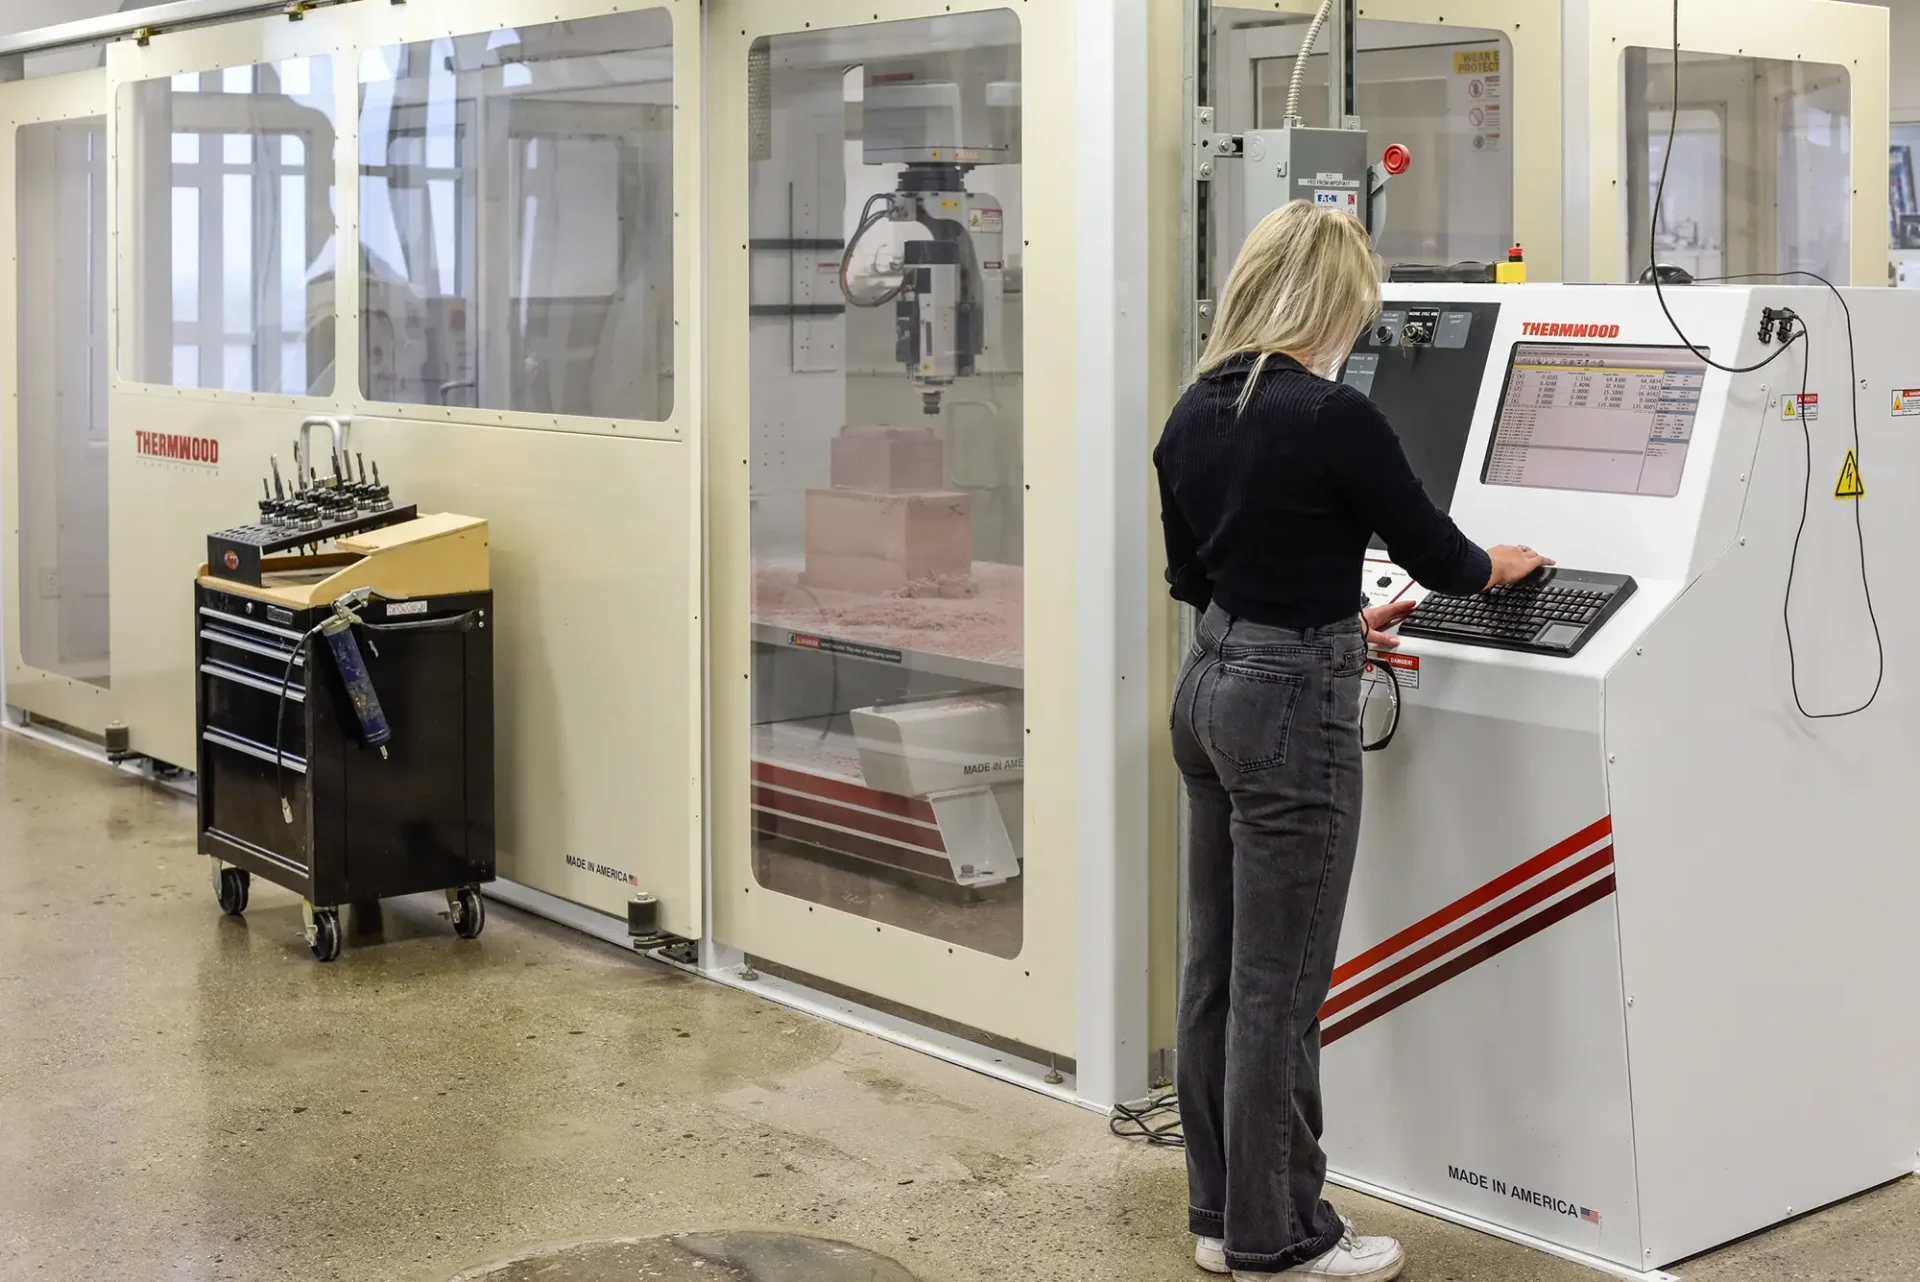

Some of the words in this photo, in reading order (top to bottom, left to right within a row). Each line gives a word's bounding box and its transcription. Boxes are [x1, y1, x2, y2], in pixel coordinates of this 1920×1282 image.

[1462, 52, 1490, 62] WEAR
[1522, 322, 1620, 338] THERMWOOD
[136, 430, 218, 463] THERMWOOD
[1390, 657, 1413, 666] DANGER!
[964, 763, 990, 775] MADE
[993, 761, 1002, 771] IN
[566, 854, 586, 870] MADE
[588, 861, 594, 873] IN
[596, 864, 628, 883] AMERICA
[1448, 1165, 1488, 1190] MADE
[1492, 1179, 1506, 1196] IN
[1510, 1186, 1578, 1218] AMERICA
